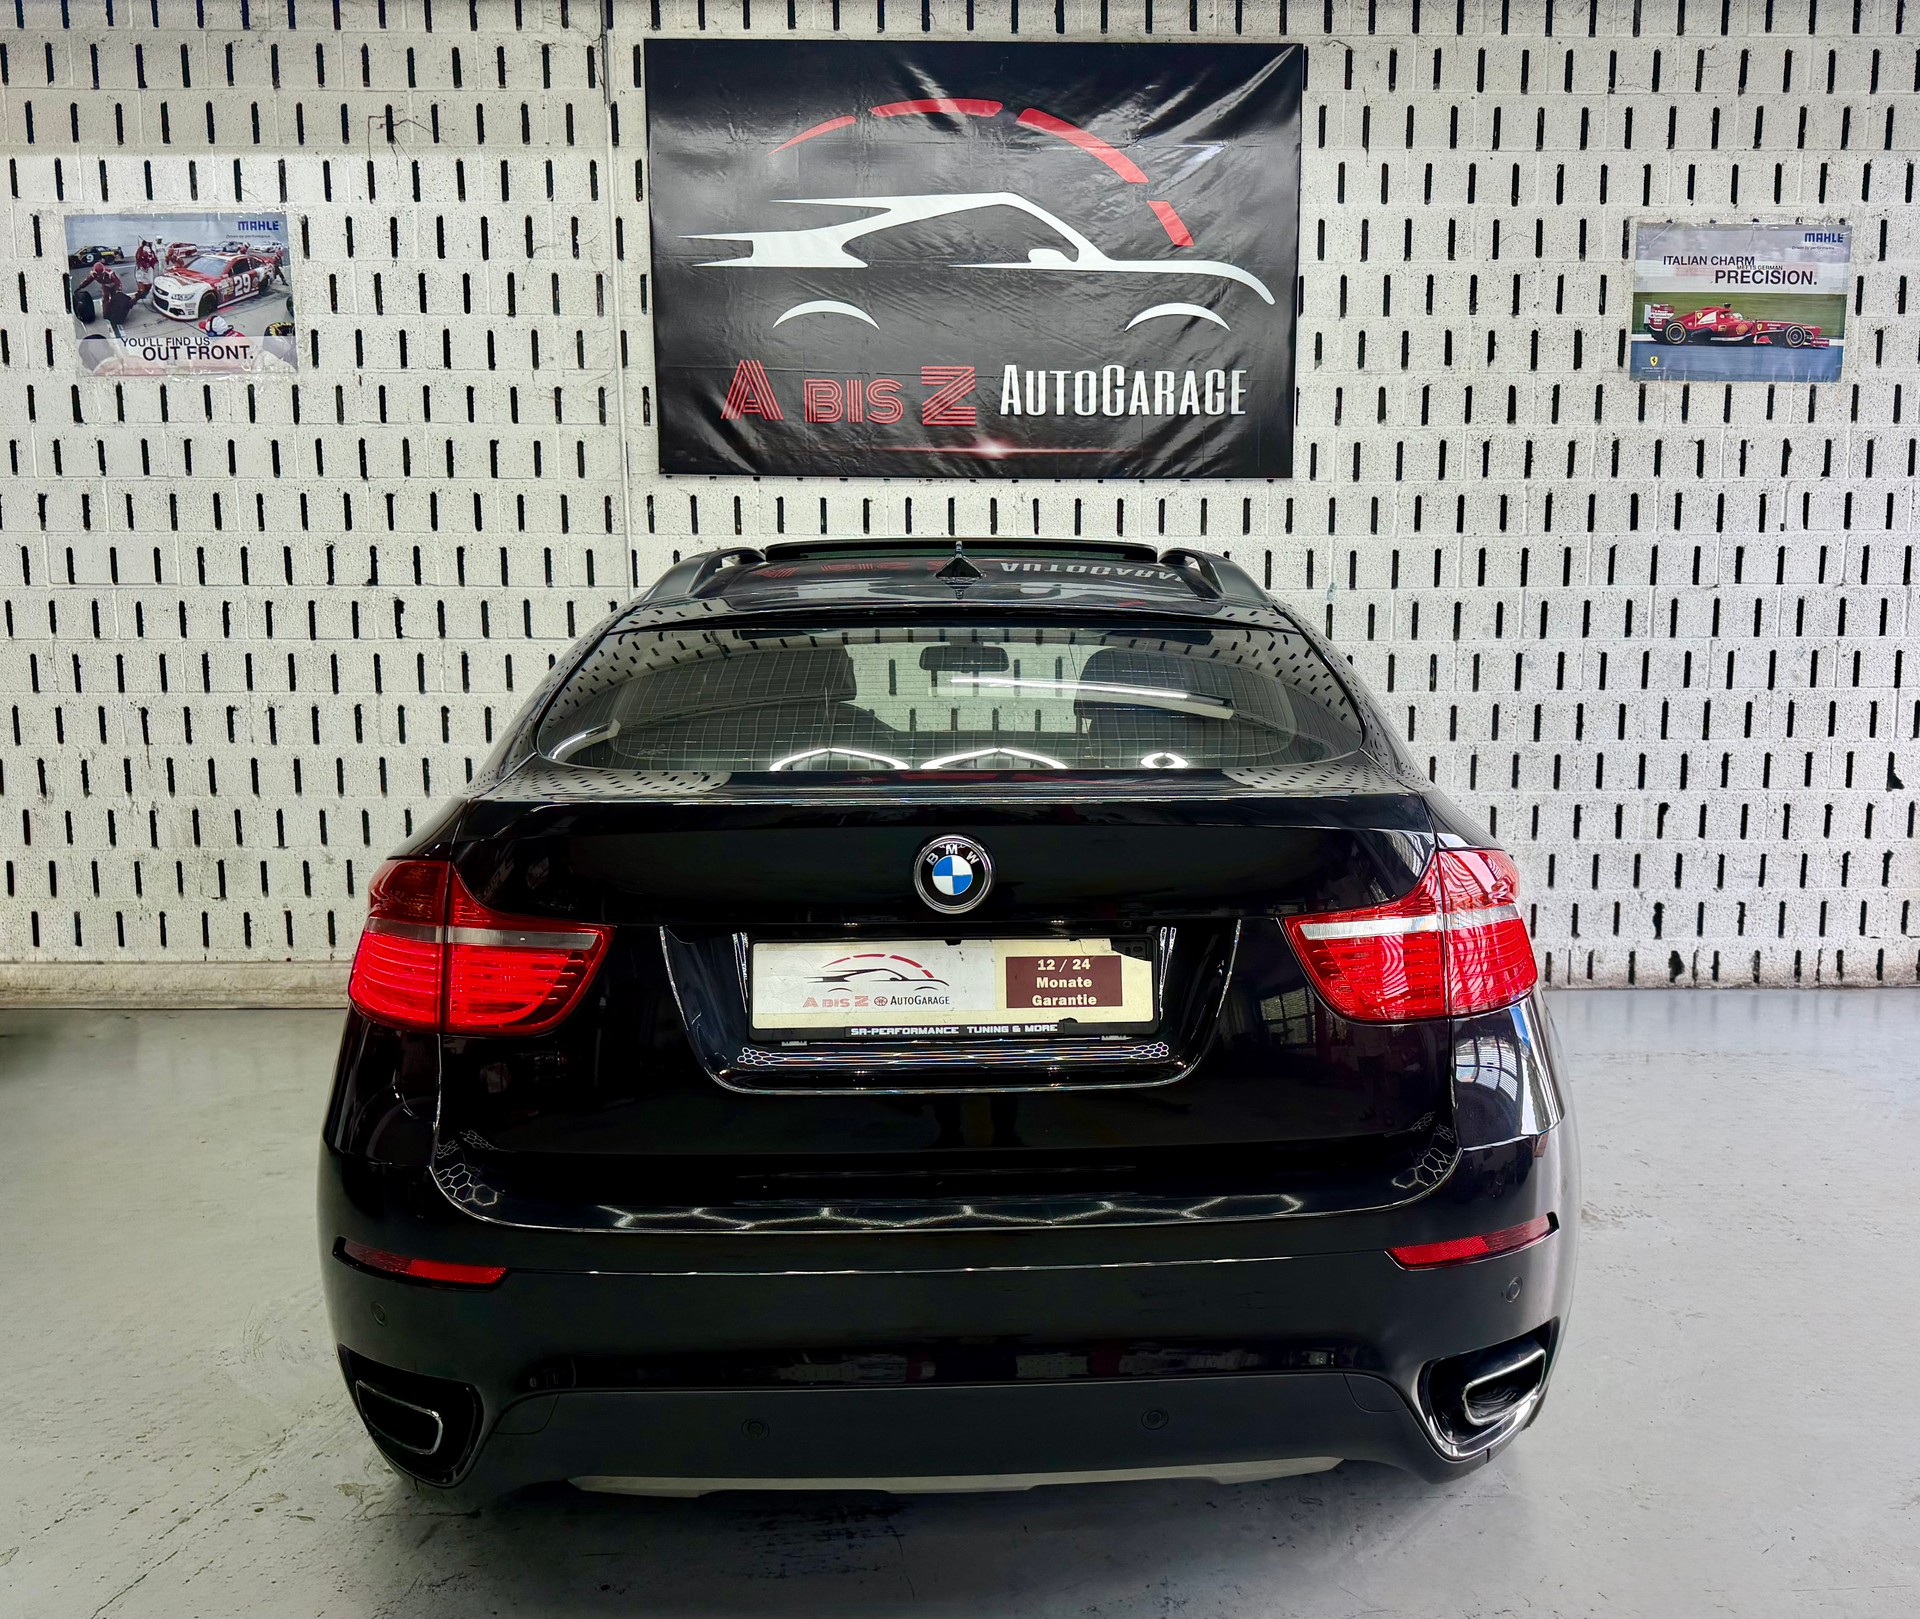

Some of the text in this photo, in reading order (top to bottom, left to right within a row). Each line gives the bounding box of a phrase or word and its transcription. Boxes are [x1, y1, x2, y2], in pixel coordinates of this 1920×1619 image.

[238, 221, 279, 231] MAHLE
[1804, 233, 1844, 243] MAHLE
[1663, 256, 1755, 266] ITALIAN CHARM
[1714, 269, 1818, 286] PRECISION.
[234, 273, 252, 297] 29
[122, 337, 210, 347] YOU'LL FIND US
[142, 345, 254, 361] OUT FRONT.
[721, 359, 784, 421] A
[803, 378, 904, 425] BIS
[920, 365, 977, 426] Z
[926, 843, 980, 866] BMW
[1037, 958, 1056, 971] 12
[1072, 958, 1091, 970] 24
[1036, 976, 1092, 989] Monate
[802, 996, 819, 1008] A
[822, 998, 850, 1008] BIS
[854, 995, 869, 1007] Z
[1031, 994, 1098, 1007] Garantie
[850, 1024, 1058, 1036] SR-PERFORMANCE TUNING & MORE
